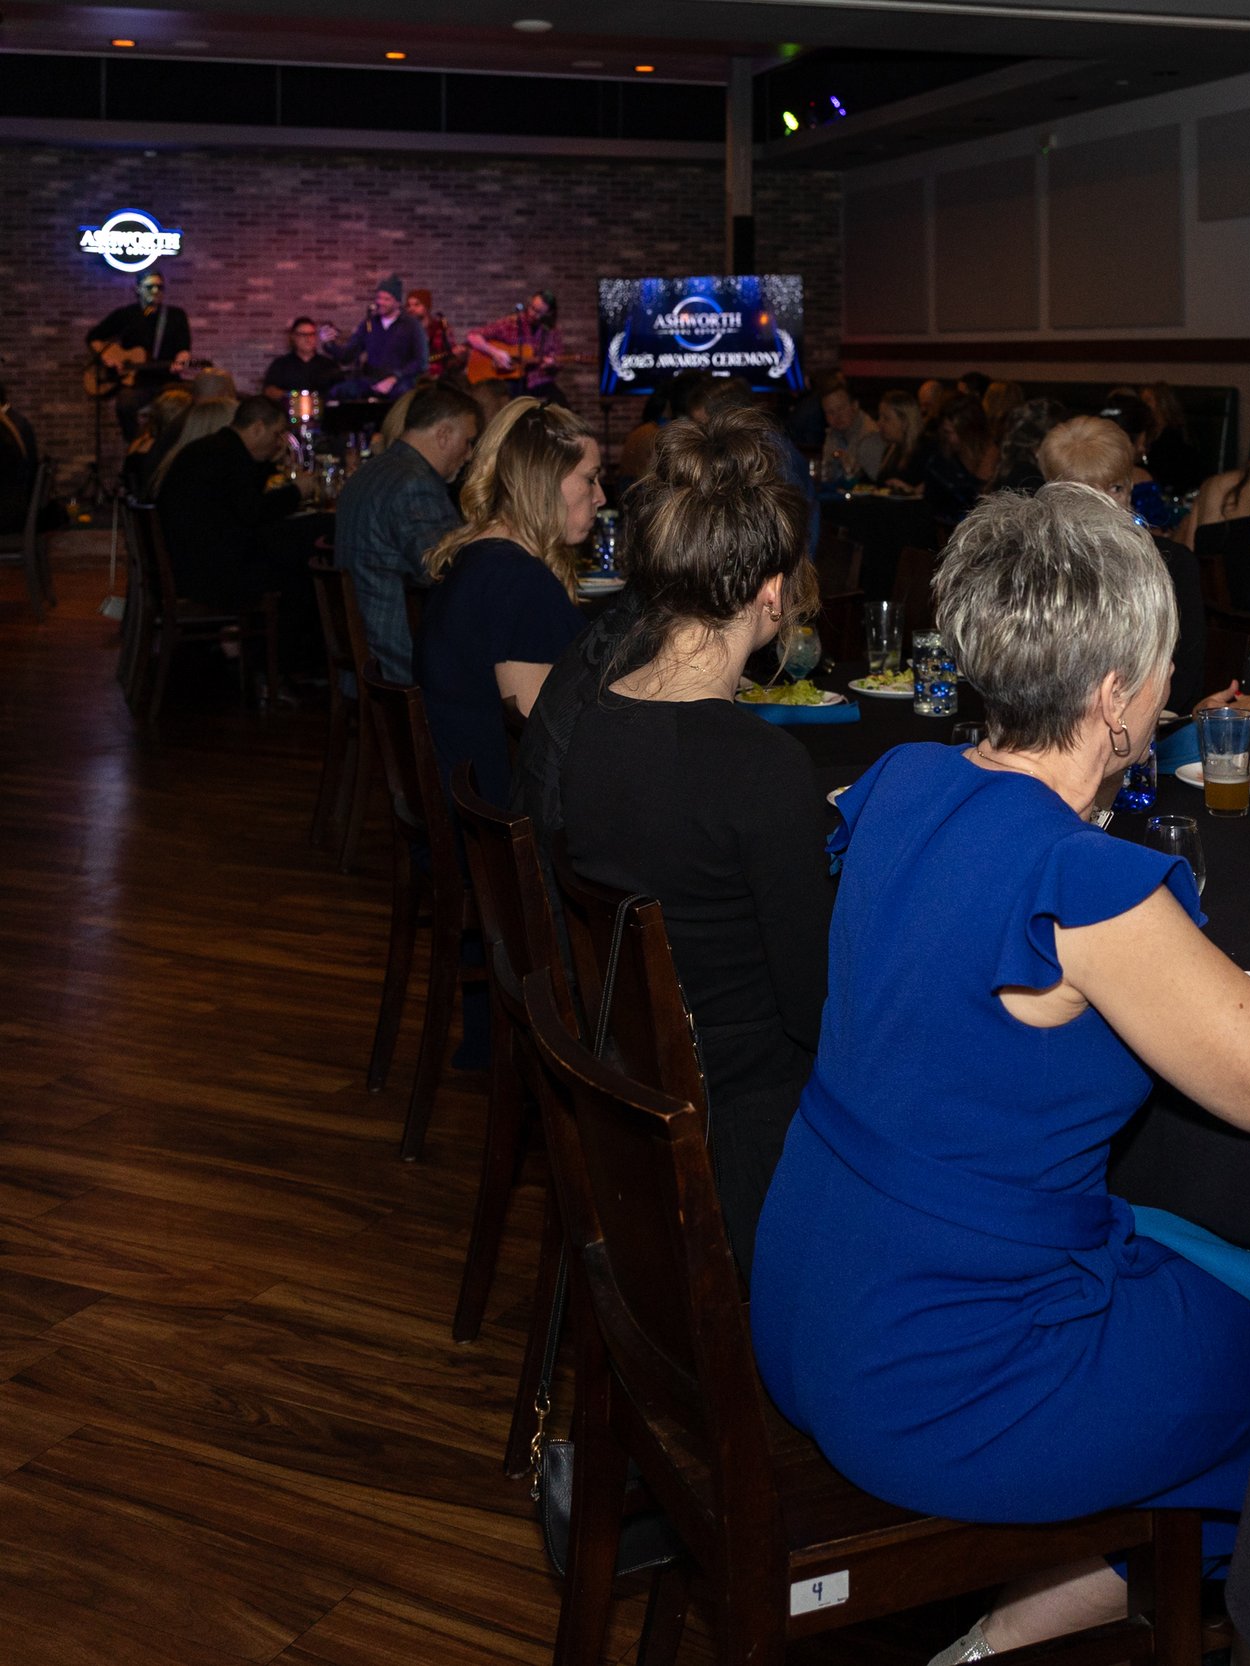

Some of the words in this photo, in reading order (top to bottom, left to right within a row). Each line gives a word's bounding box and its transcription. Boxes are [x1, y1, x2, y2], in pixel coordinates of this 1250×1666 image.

[654, 312, 742, 330] ASHWORTH
[656, 353, 711, 369] AWARDS
[712, 351, 780, 367] CEREMONY
[812, 1581, 823, 1602] 4
